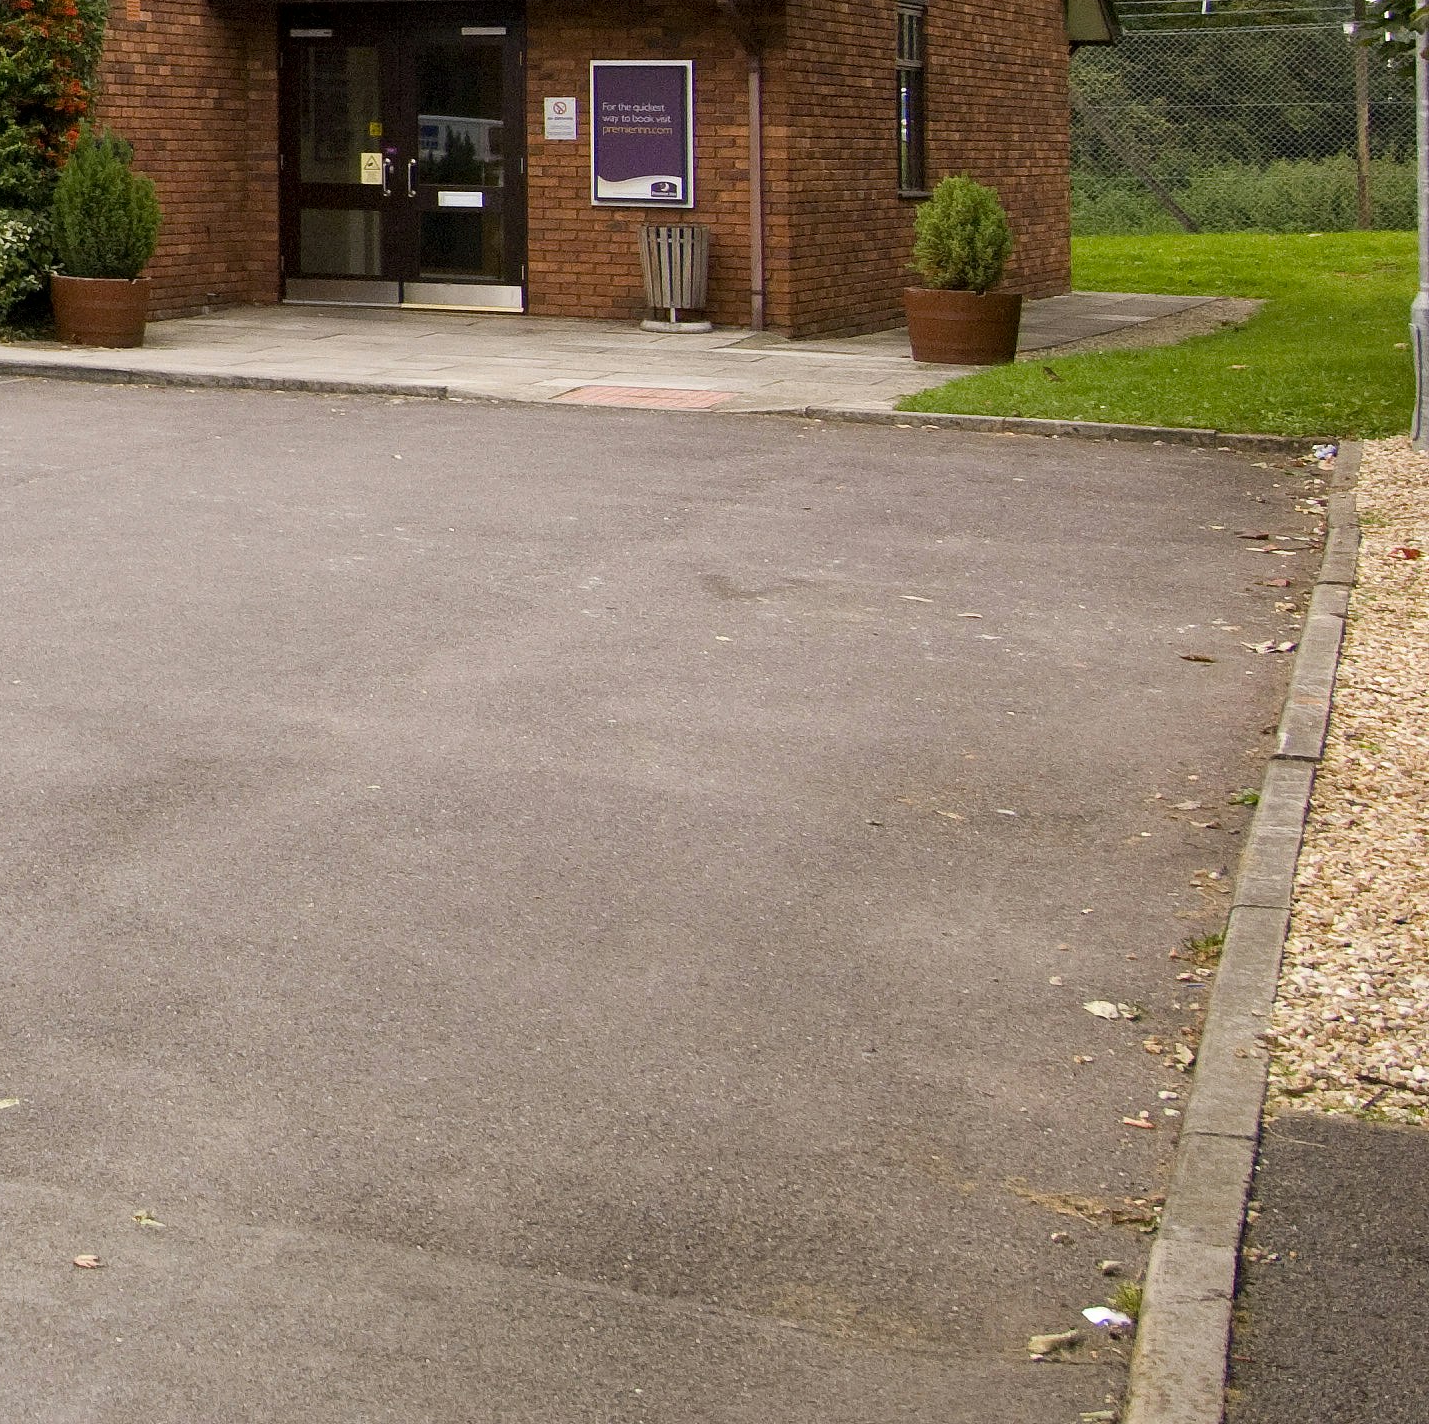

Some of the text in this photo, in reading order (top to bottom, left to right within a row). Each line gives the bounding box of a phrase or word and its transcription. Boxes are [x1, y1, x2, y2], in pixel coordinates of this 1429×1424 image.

[603, 102, 616, 111] For
[618, 102, 631, 111] the
[602, 114, 672, 124] way to book visit
